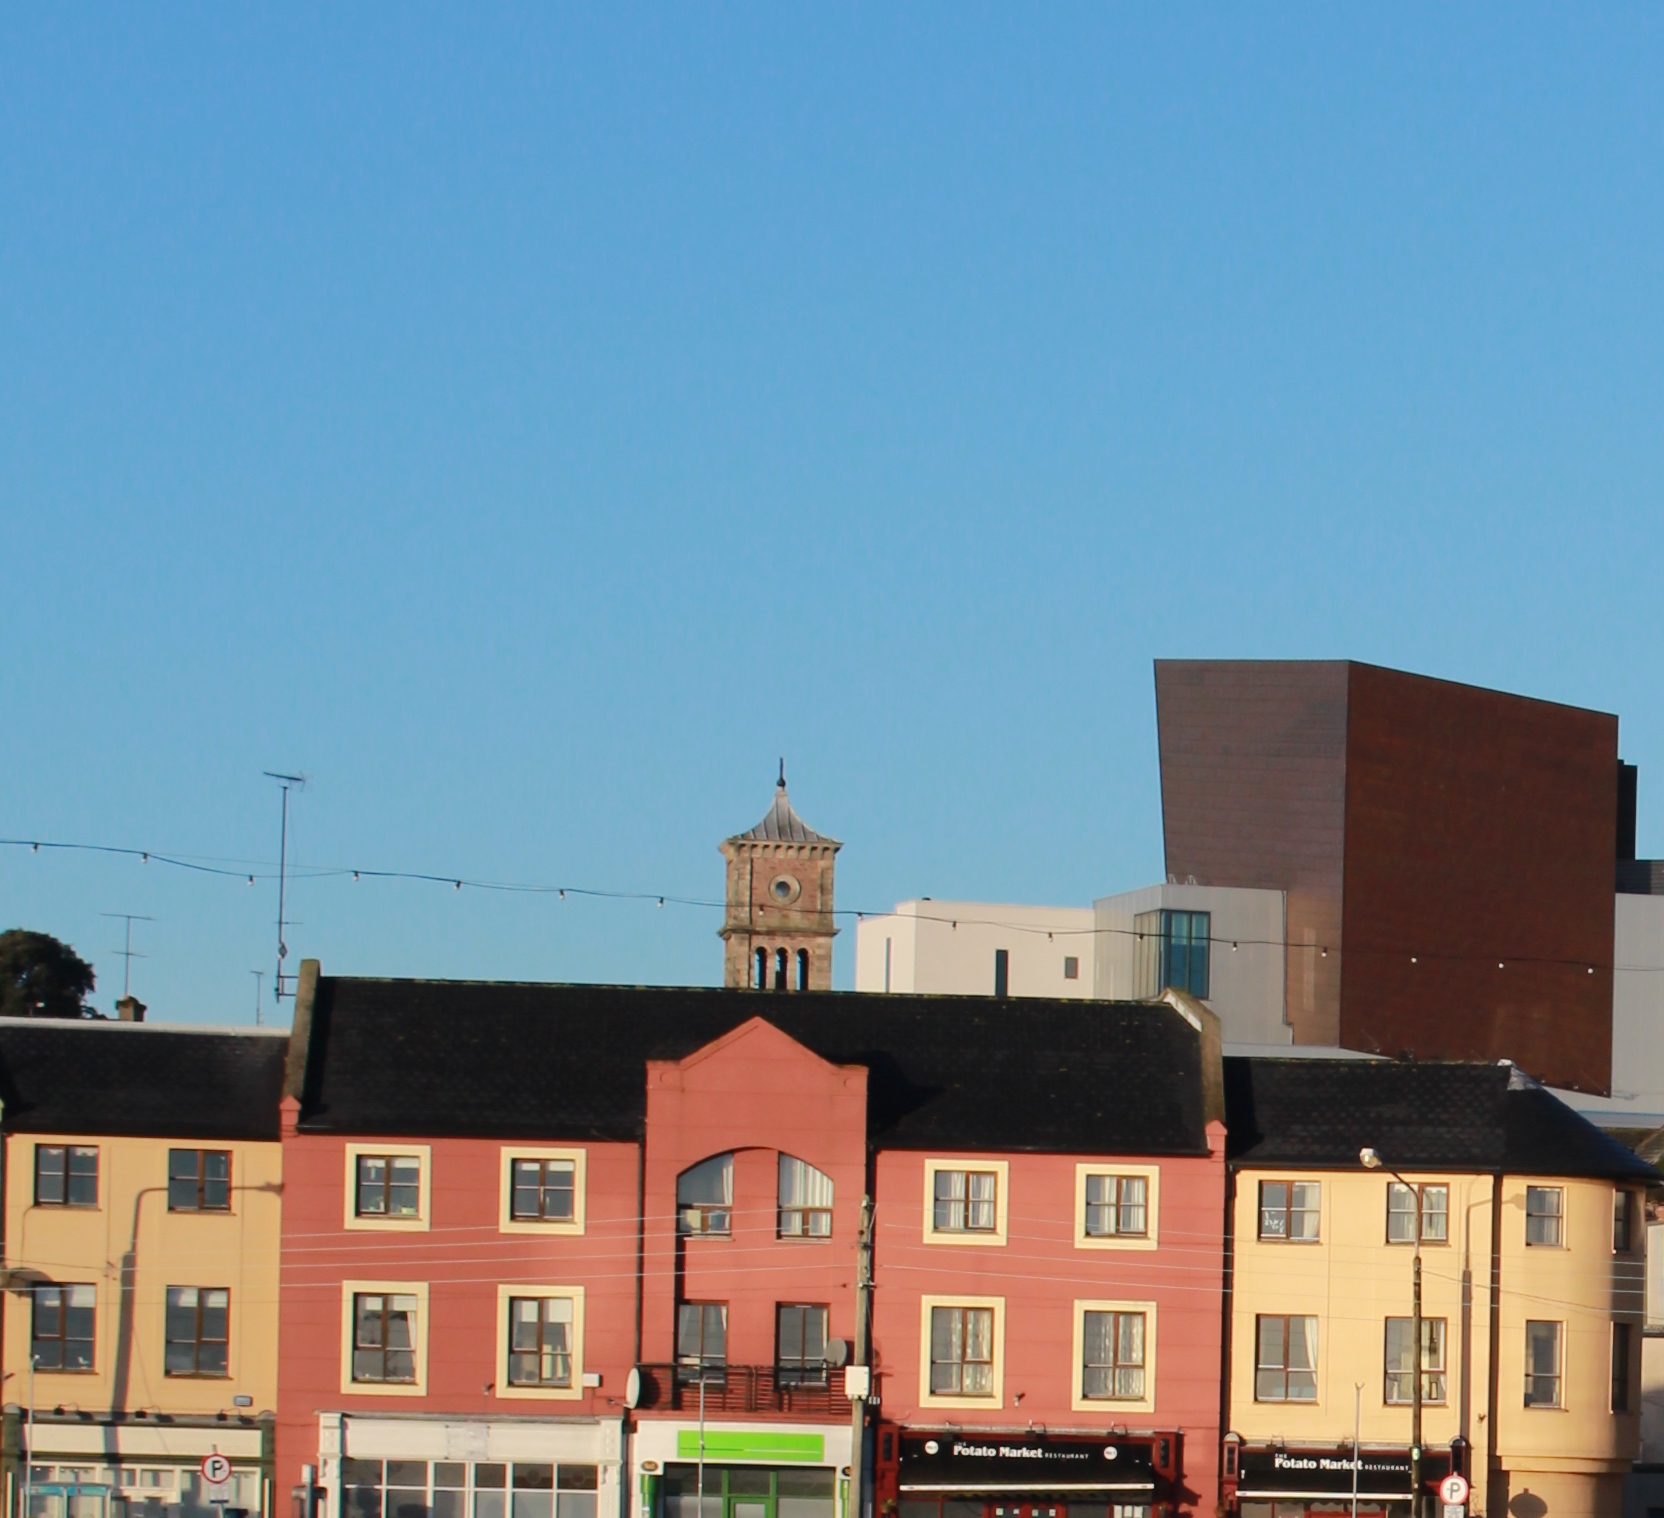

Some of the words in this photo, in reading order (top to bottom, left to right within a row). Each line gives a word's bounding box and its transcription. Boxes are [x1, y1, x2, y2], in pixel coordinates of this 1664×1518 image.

[953, 1445, 997, 1456] Potato
[999, 1446, 1043, 1458] Market
[211, 1460, 224, 1478] P
[1274, 1458, 1317, 1469] Potato
[1319, 1459, 1363, 1470] Market
[1450, 1482, 1461, 1500] P
